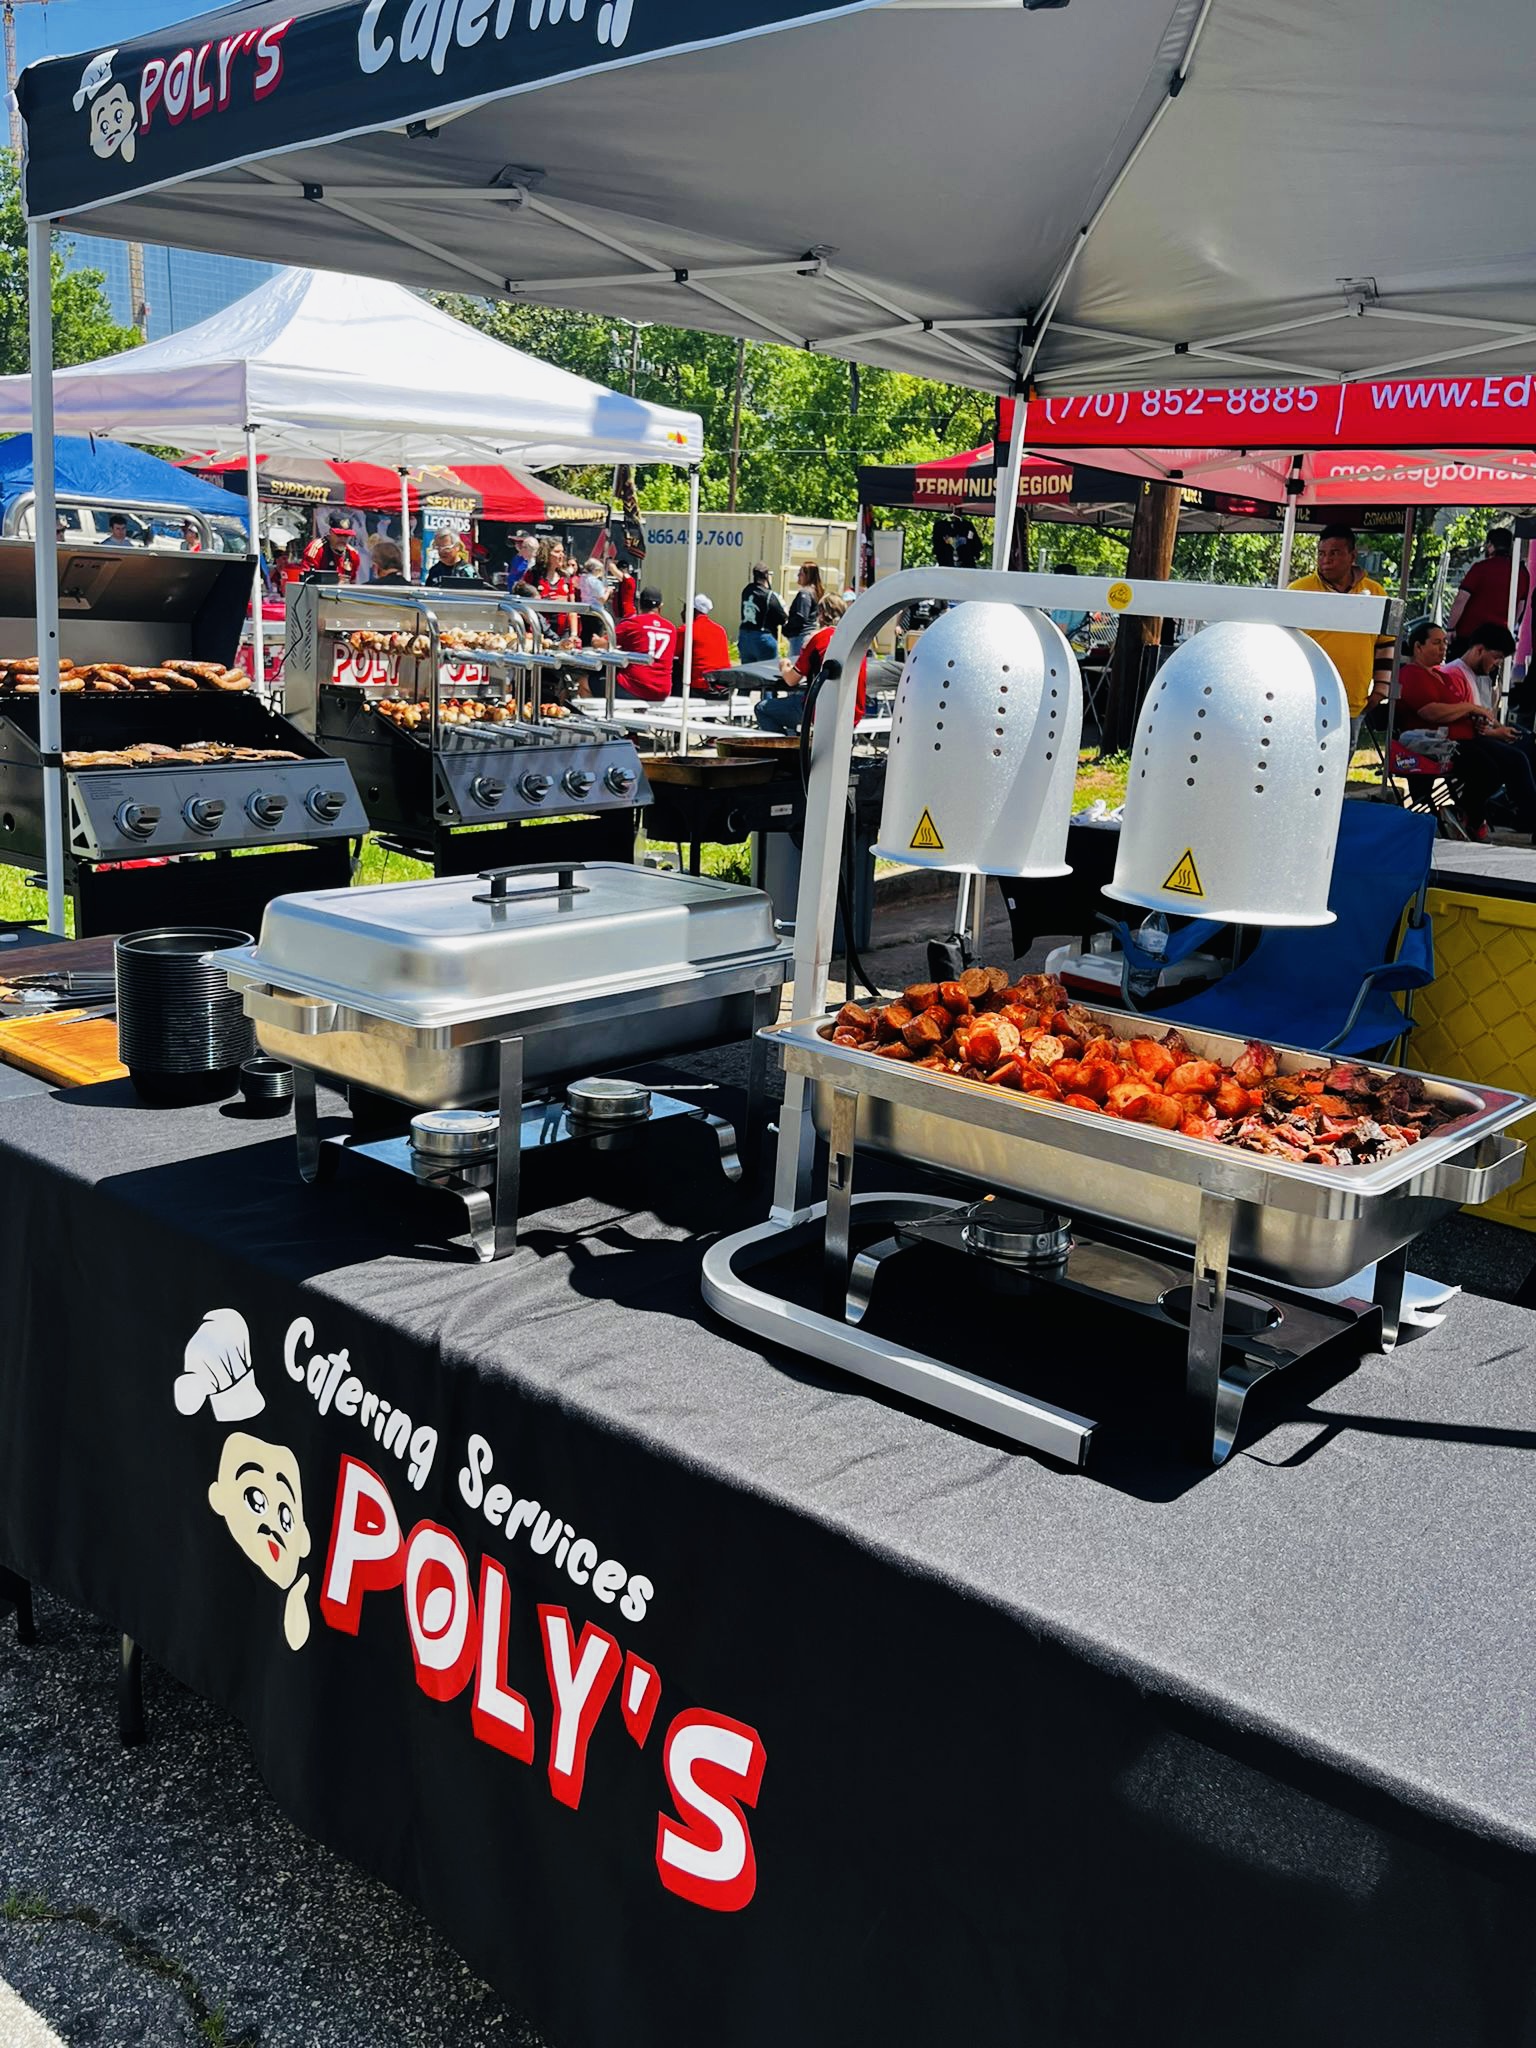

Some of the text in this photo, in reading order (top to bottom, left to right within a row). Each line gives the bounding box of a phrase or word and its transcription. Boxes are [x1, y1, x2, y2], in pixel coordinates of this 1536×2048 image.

[139, 17, 296, 136] POLY'S
[1141, 386, 1318, 416] 852-8885
[1371, 375, 1536, 410] www.Ed
[270, 480, 331, 503] SUPPORT
[1018, 474, 1073, 497] EGION
[426, 495, 476, 512] SERVICE
[546, 505, 609, 523] COMMUNITY
[424, 514, 470, 533] LEGENDS
[647, 528, 744, 547] 866.49.7600
[647, 631, 670, 660] 17
[284, 1316, 654, 1622] Catering Services
[320, 1453, 767, 1912] POLY'S
